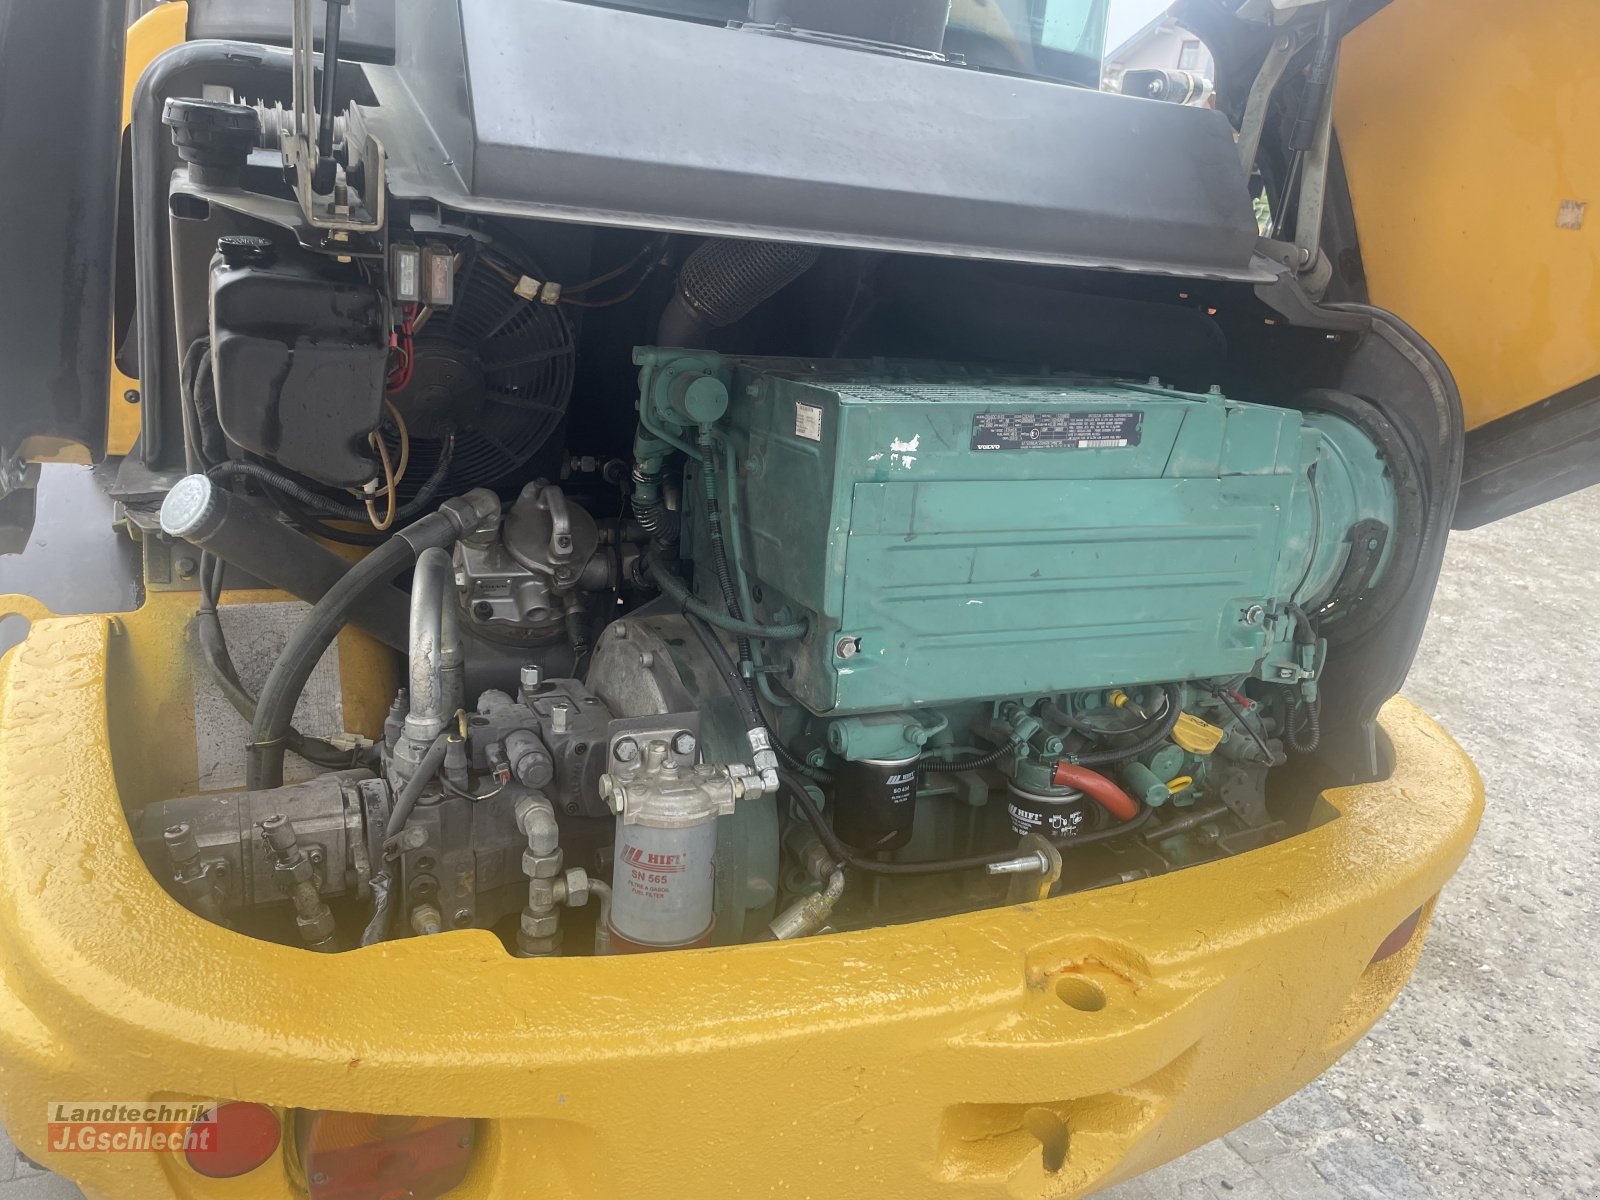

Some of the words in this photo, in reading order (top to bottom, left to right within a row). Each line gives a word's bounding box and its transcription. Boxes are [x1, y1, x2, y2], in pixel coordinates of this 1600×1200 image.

[631, 870, 645, 880] SN
[648, 874, 668, 884] 565
[631, 888, 644, 896] FUEL
